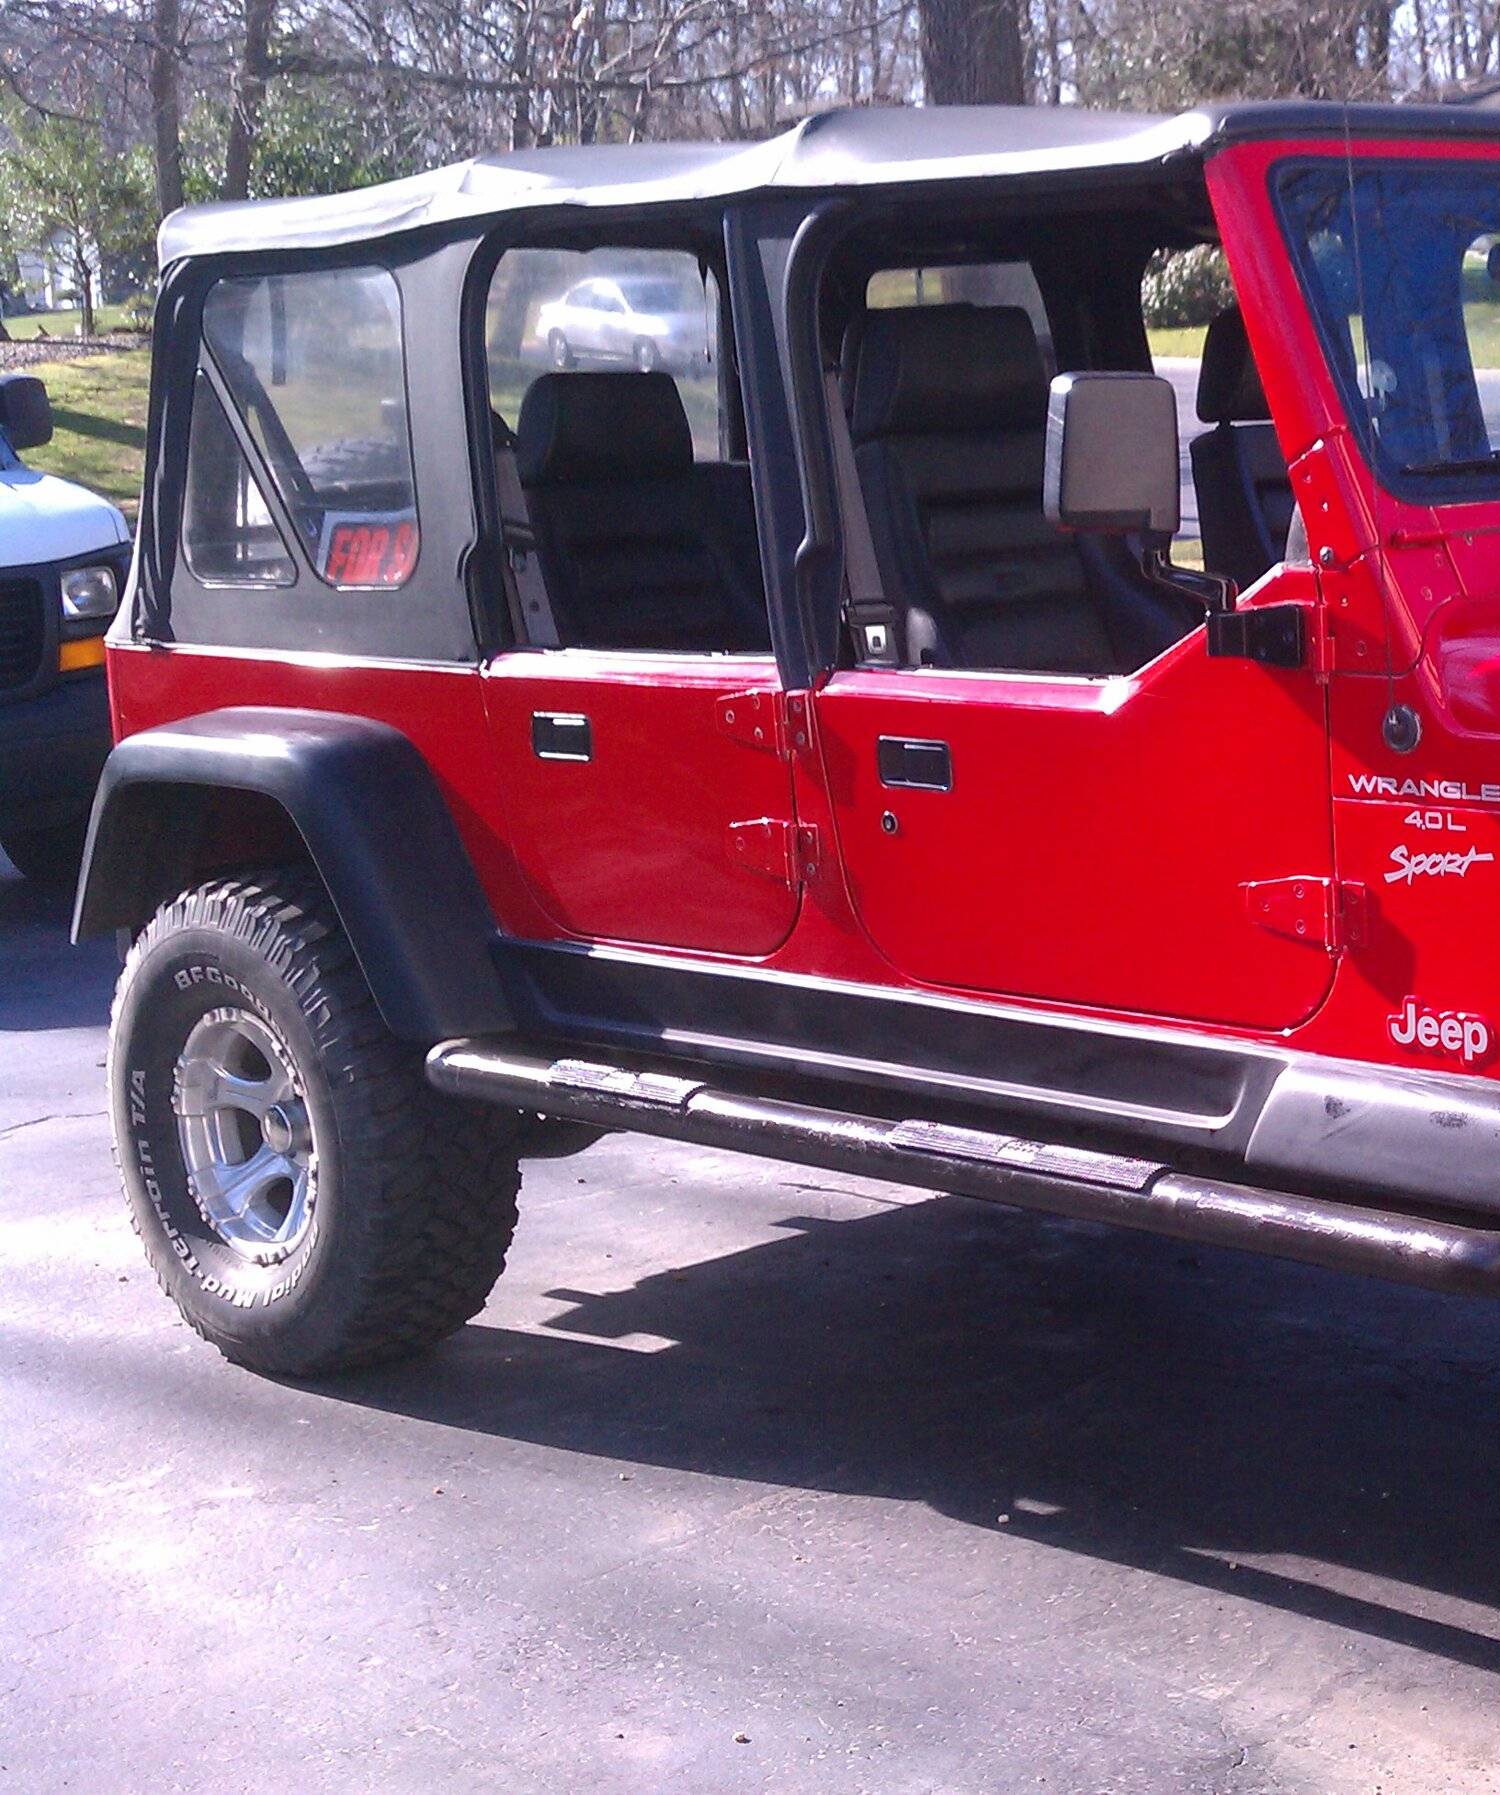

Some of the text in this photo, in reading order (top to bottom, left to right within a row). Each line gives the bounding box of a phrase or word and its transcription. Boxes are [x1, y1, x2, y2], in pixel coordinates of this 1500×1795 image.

[327, 527, 390, 584] FOR
[1391, 1002, 1489, 1061] Jeep
[130, 1070, 146, 1127] T/A
